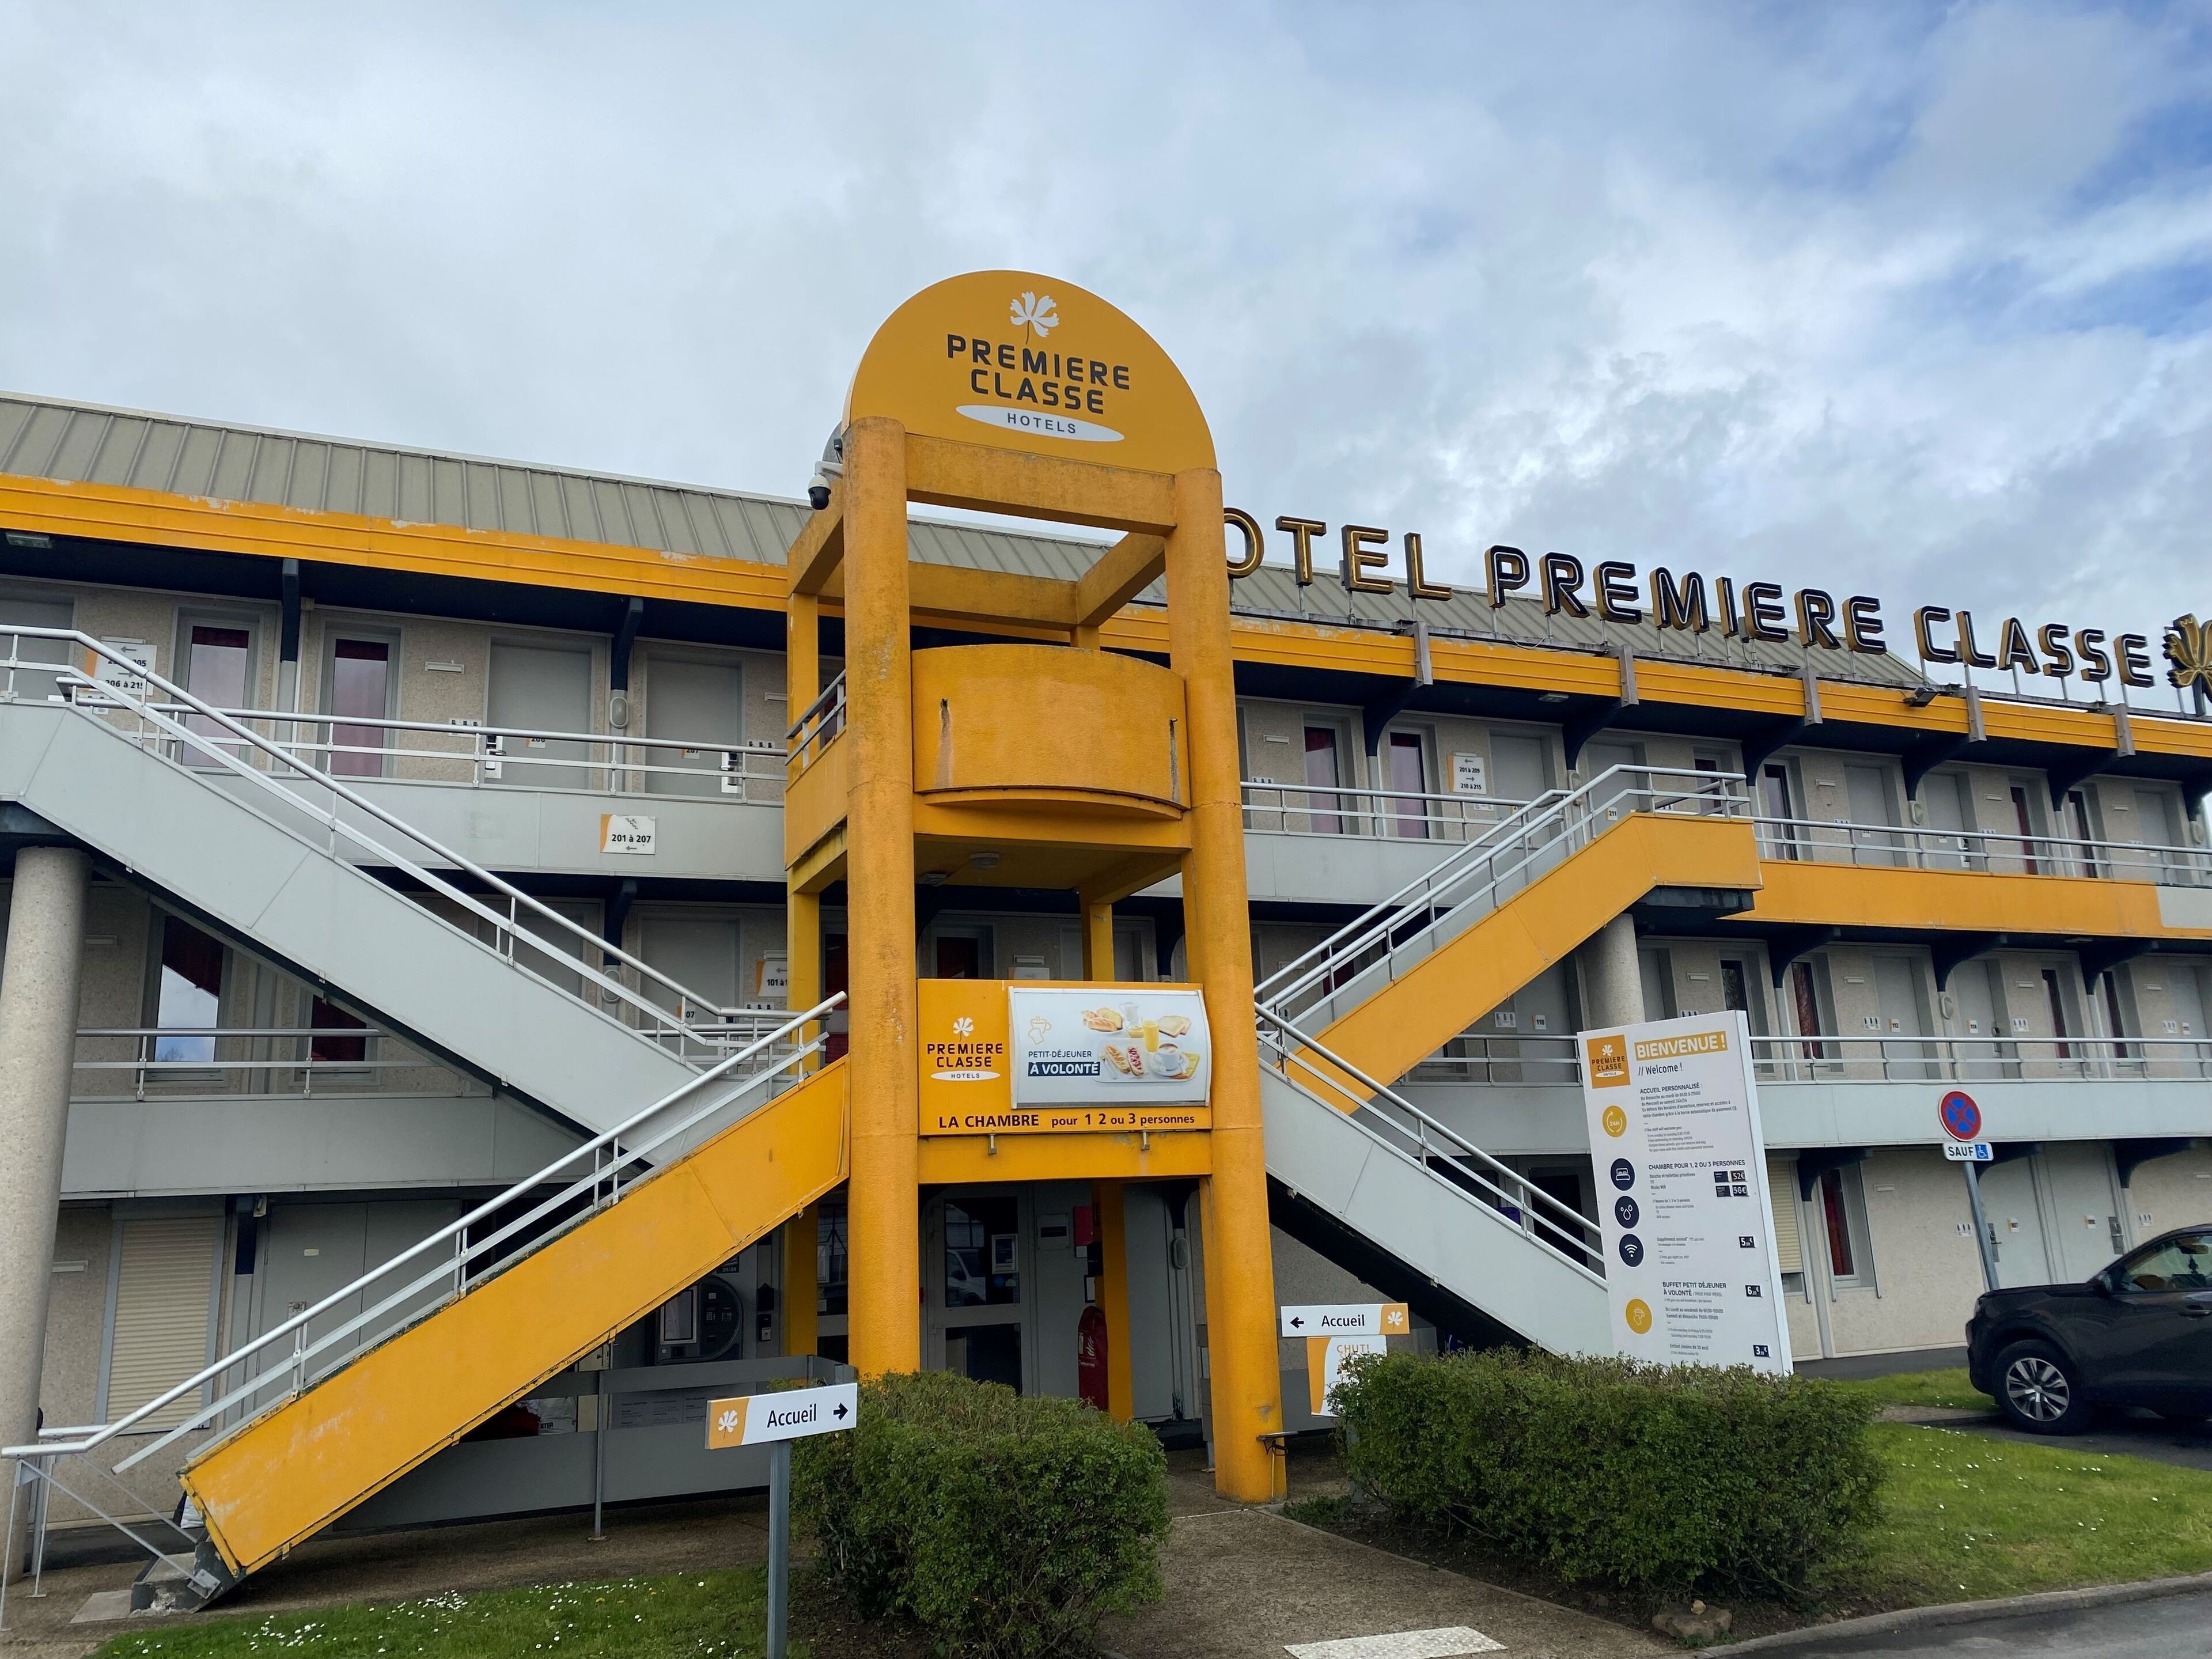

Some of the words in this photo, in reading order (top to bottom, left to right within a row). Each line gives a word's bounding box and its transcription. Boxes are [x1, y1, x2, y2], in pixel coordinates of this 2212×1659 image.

[947, 334, 1130, 390] PREMIERE
[971, 369, 1104, 415] CLASSE
[1007, 412, 1076, 434] HOTELS
[1224, 507, 1452, 601] OTEL
[1484, 545, 1887, 655] PREMIERE
[1914, 605, 2155, 688] CLASSE
[628, 834, 634, 842] à
[927, 1043, 1003, 1055] PREMIERE
[1637, 1035, 1718, 1058] BIENVENUE
[1028, 1049, 1092, 1058] PETIT-DÉJEUNER
[937, 1056, 992, 1067] CLASSE
[1592, 1055, 1625, 1065] PREMIERE
[1030, 1062, 1039, 1074] À
[1041, 1061, 1099, 1074] VOLONTÉ
[1597, 1063, 1622, 1071] CLASSE
[1646, 1065, 1678, 1075] Welcome
[1661, 1082, 1700, 1092] PERSONNALISÉ
[939, 1116, 960, 1128] LA
[964, 1114, 1039, 1127] CHAMBRE
[1051, 1116, 1078, 1128] pour
[1084, 1113, 1091, 1125] 1
[1099, 1113, 1107, 1124] 2
[1111, 1116, 1124, 1124] ou
[1128, 1112, 1136, 1124] 3
[1140, 1115, 1195, 1126] personnes
[1948, 1146, 1974, 1157] SAUF
[1321, 1314, 1365, 1327] Accueil
[767, 1404, 817, 1428] Accueil
